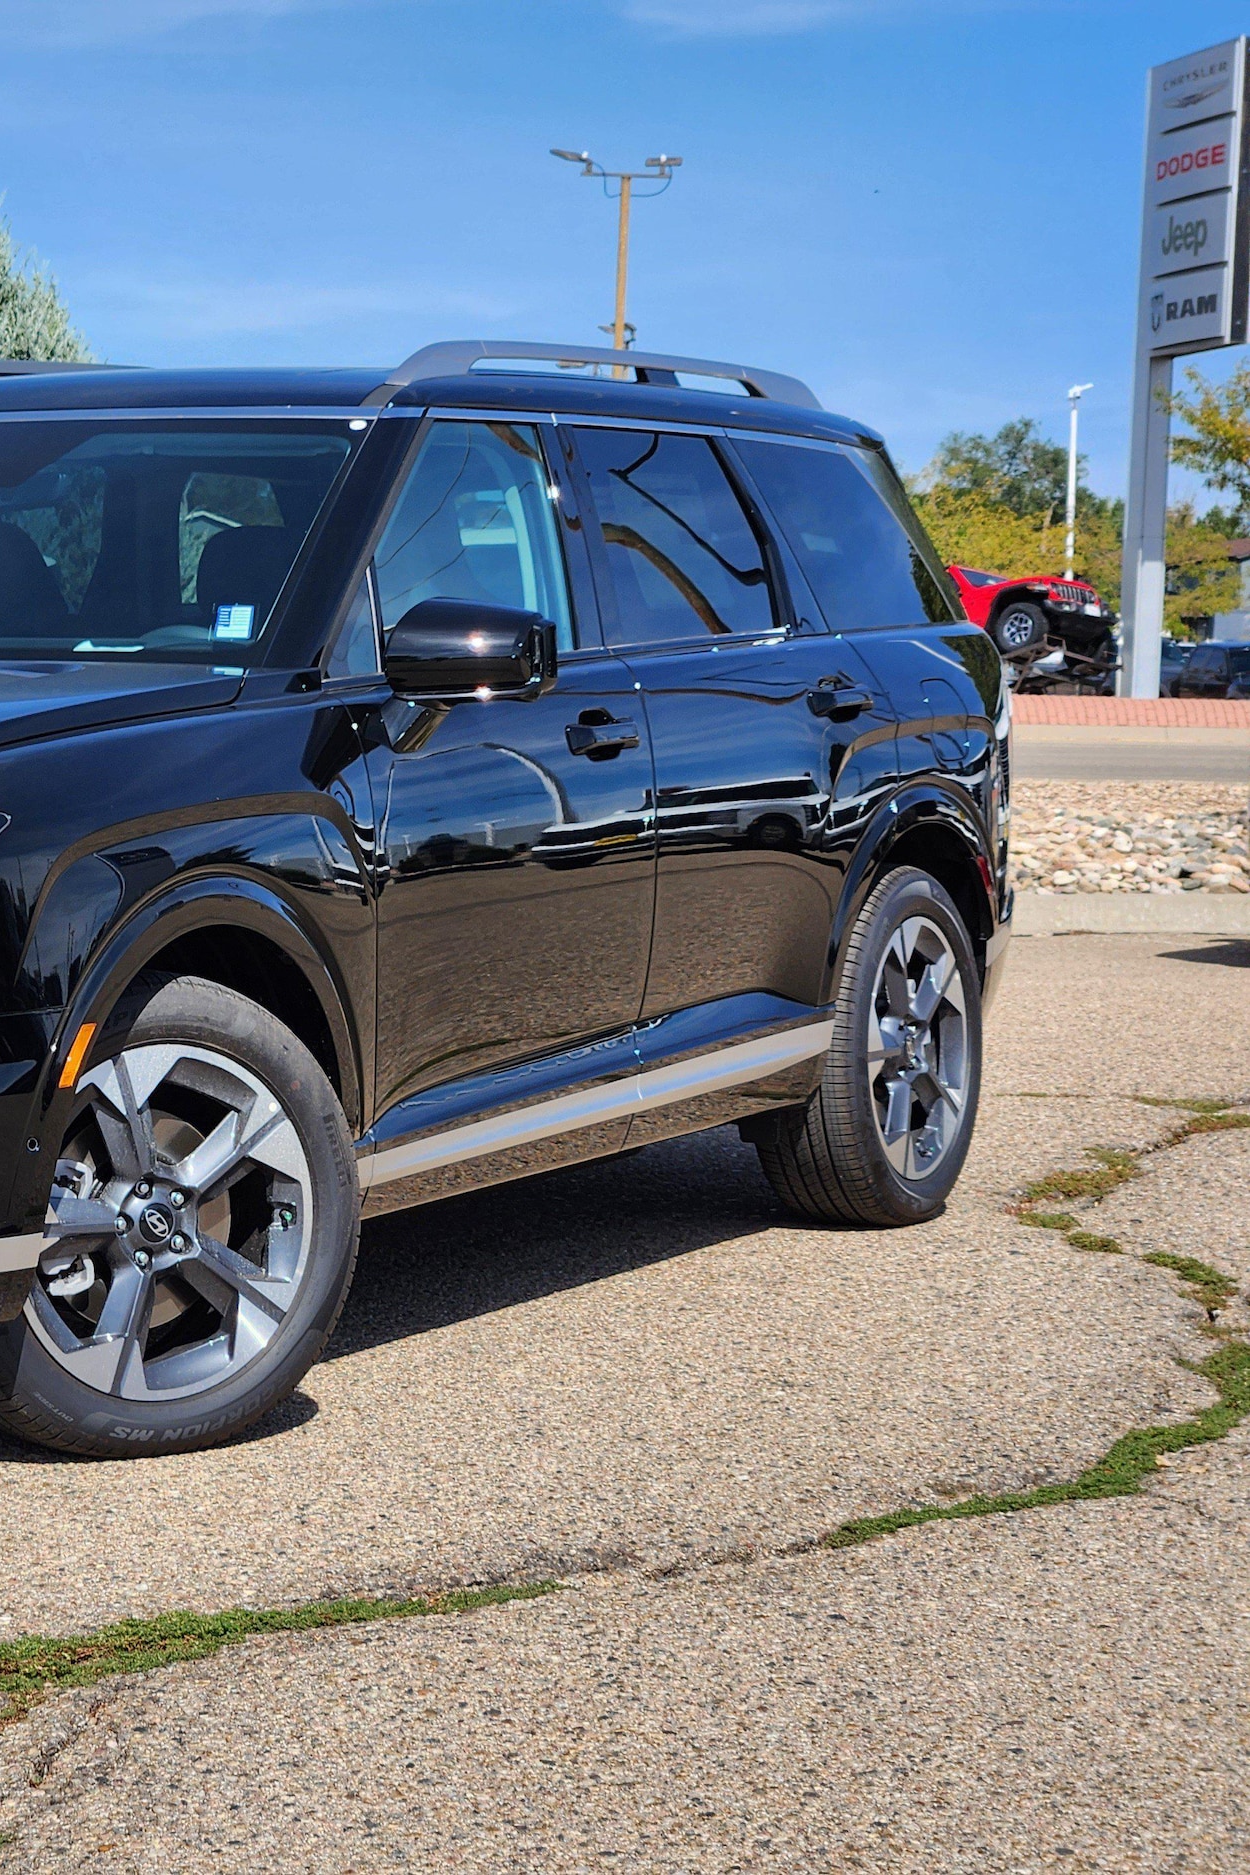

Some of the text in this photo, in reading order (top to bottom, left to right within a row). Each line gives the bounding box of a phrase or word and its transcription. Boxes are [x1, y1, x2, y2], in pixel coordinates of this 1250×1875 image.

[1163, 61, 1227, 92] CHRYSLER
[1157, 144, 1226, 181] DODGE
[1161, 216, 1207, 256] Jeep
[1166, 294, 1217, 321] RAM
[109, 1426, 155, 1441] MS
